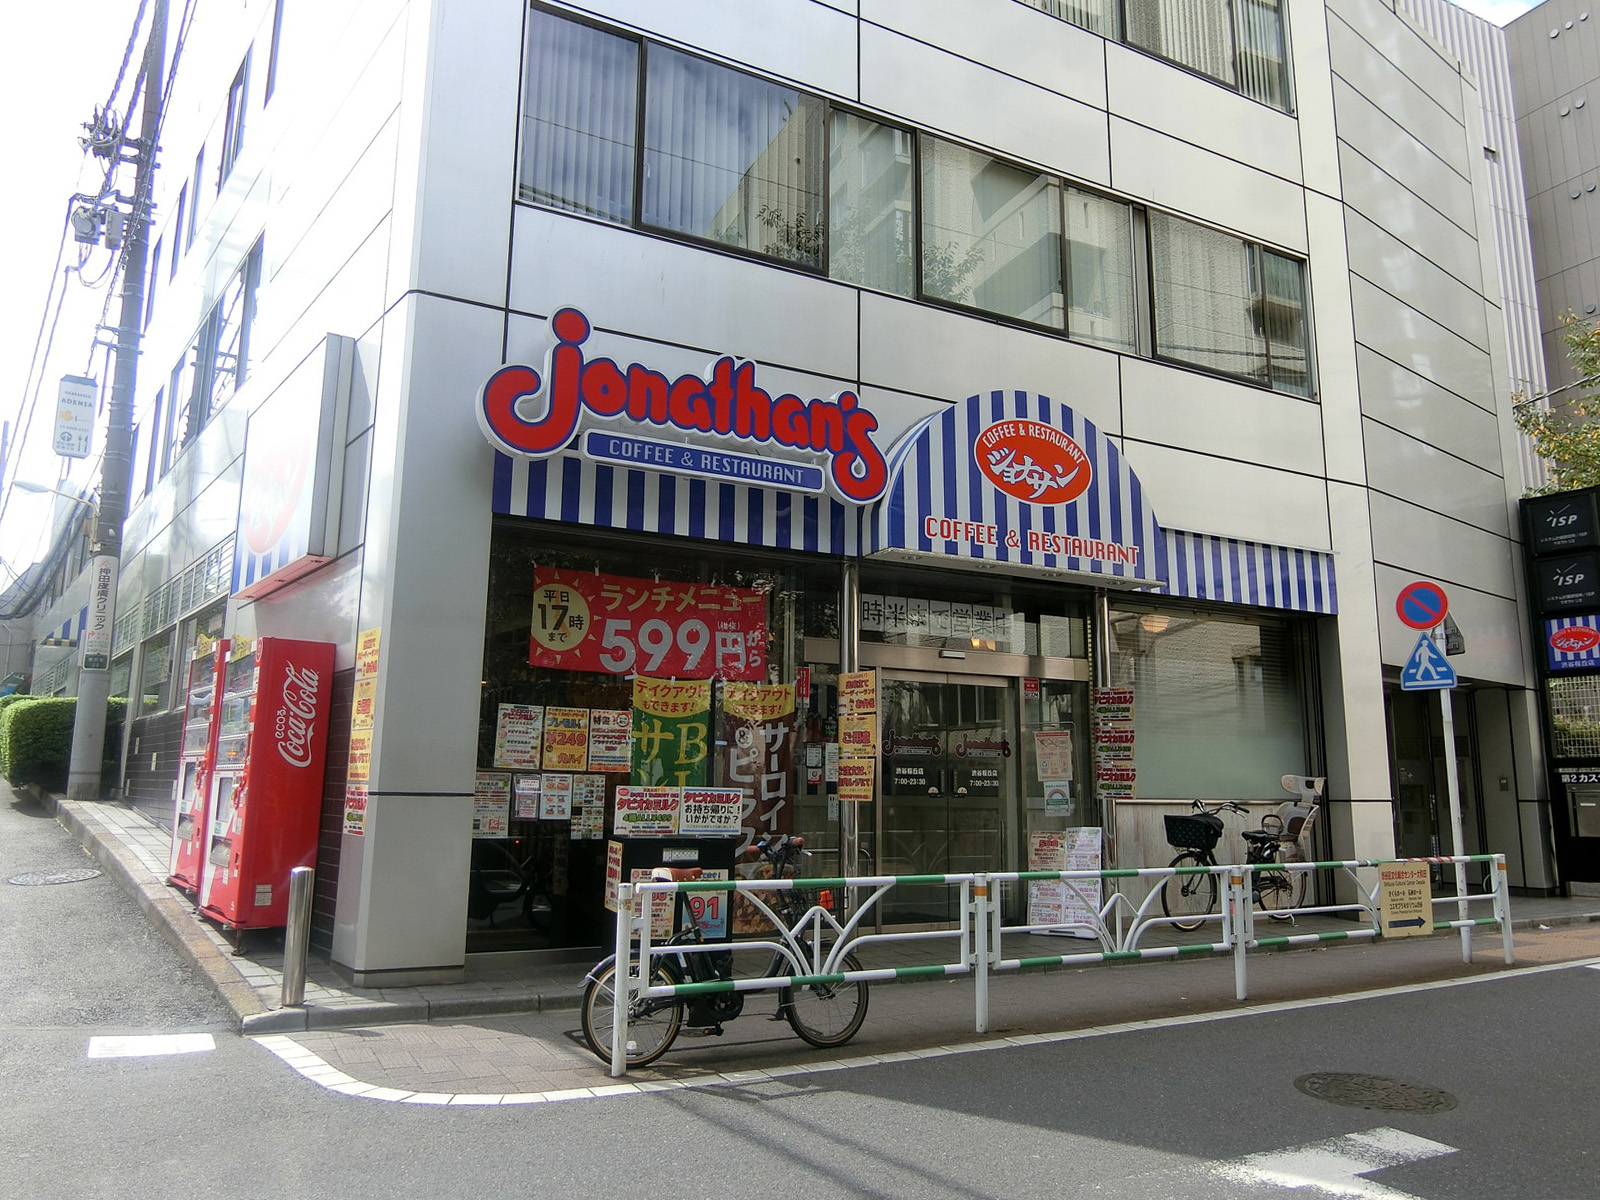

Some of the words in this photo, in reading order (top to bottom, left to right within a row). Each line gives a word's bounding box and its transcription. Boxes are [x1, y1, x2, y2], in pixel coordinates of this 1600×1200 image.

[483, 308, 888, 501] jonathan's
[982, 424, 1016, 448] COFFEE
[1018, 423, 1026, 436] &
[1028, 424, 1085, 464] RESTAURANT
[609, 439, 673, 464] COFFEE
[680, 452, 694, 467] &
[701, 454, 804, 484] RESTAURANT
[986, 447, 1080, 499] ジョナサン
[1551, 514, 1578, 528] ISP
[926, 517, 996, 545] COFFEE
[1006, 529, 1020, 548] &
[1028, 531, 1138, 564] RESTAURANT
[1558, 573, 1585, 586] ISP
[543, 589, 570, 603] 平日
[600, 583, 762, 613] ランチメニュー
[537, 604, 584, 631] 17時
[548, 632, 567, 643] まで
[642, 700, 696, 712] もできます!
[278, 660, 319, 767] Coca-Cola
[546, 732, 587, 747] ¥249
[1561, 774, 1600, 784] 第2カス
[617, 797, 679, 811] タピオカミルク
[684, 792, 740, 804] タピオカミルク
[685, 804, 740, 815] お持ち帰りに!
[685, 814, 739, 824] いかがですか?
